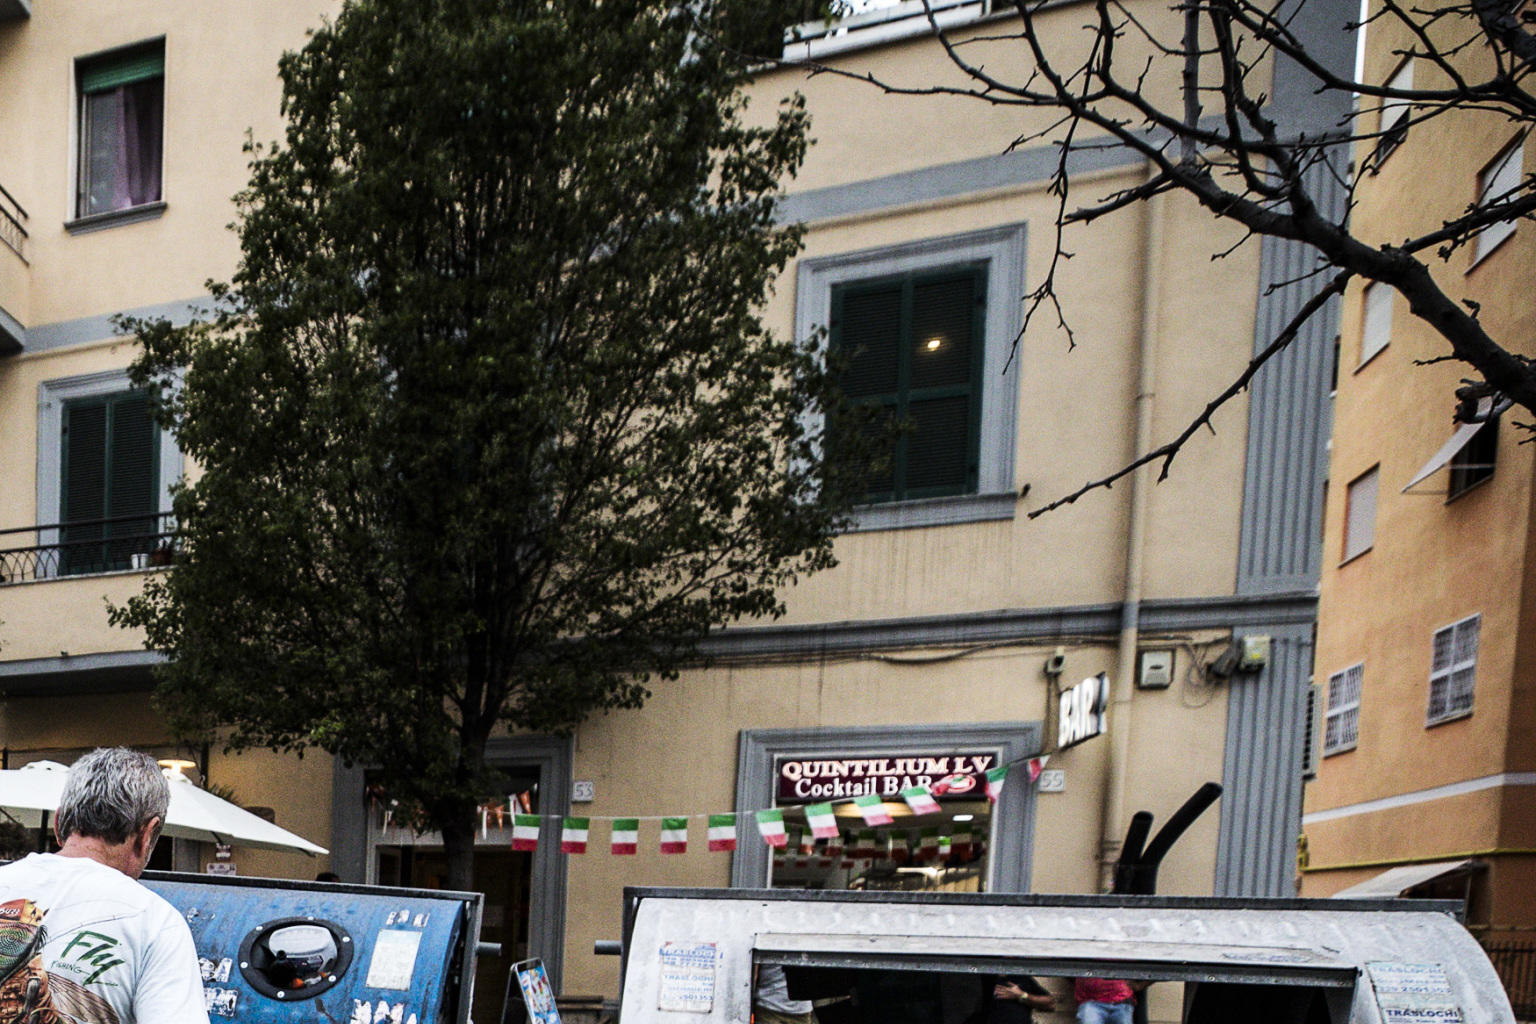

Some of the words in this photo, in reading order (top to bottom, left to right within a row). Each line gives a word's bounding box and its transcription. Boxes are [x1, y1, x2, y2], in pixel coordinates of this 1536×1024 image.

[782, 757, 950, 782] QUINTILIUM
[575, 783, 594, 798] 53
[795, 775, 877, 799] Cocktail
[883, 776, 933, 797] BAR
[1385, 1009, 1459, 1018] TRASLOCHI
